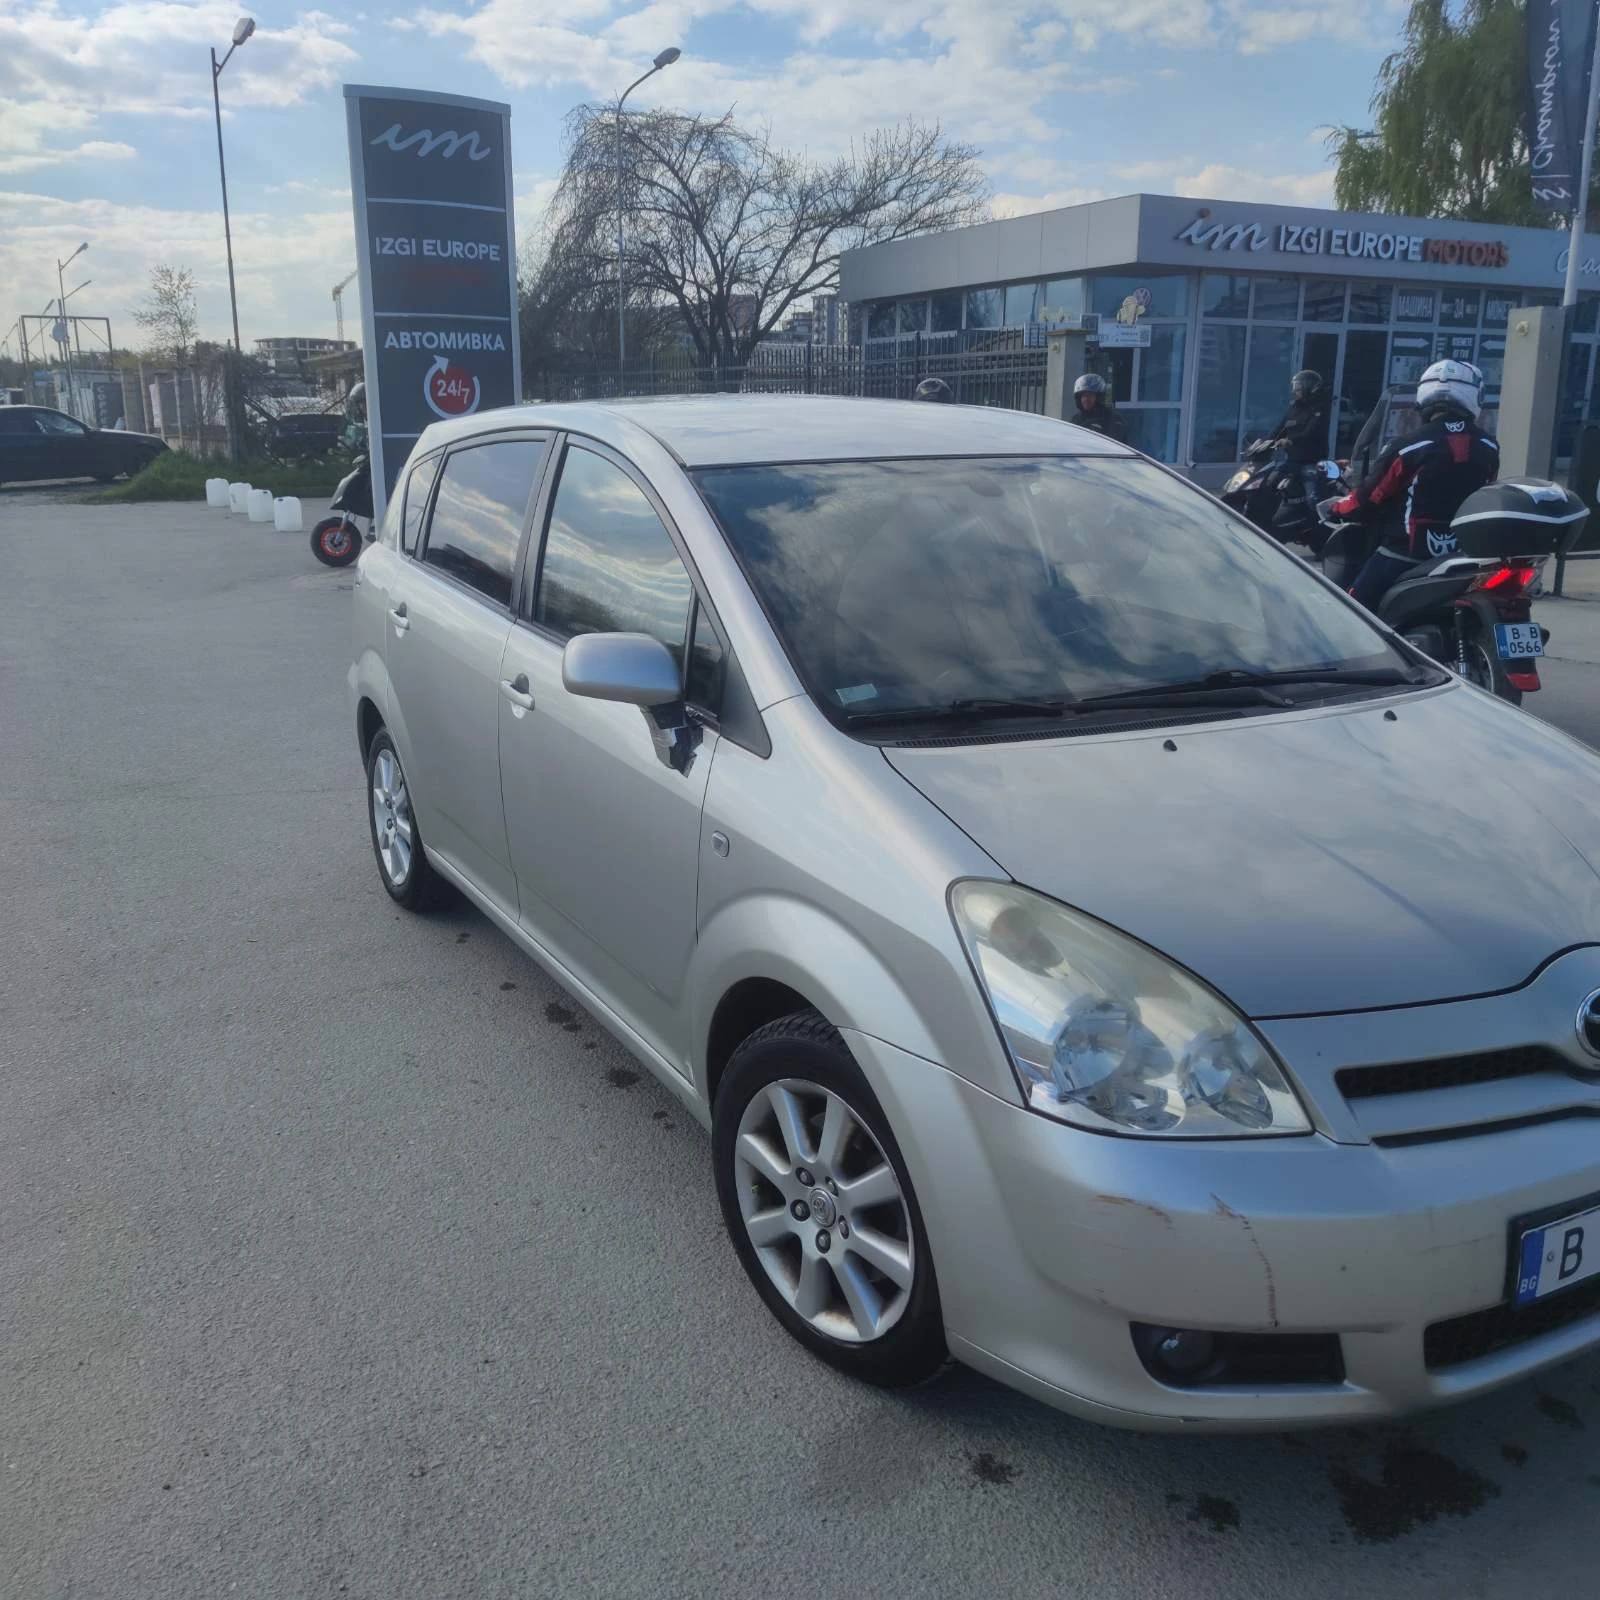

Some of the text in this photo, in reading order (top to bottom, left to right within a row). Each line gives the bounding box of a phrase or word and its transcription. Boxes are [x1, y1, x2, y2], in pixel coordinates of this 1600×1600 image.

[375, 236, 501, 261] IZGI EUROPE
[1279, 223, 1326, 254] IZGI
[1330, 227, 1421, 262] EUROPE
[1424, 238, 1510, 267] MOTORS
[384, 331, 506, 351] АВТОМИВКА
[436, 378, 470, 404] 24/7
[1512, 627, 1537, 639] B B
[1510, 641, 1541, 653] 0566
[1558, 1226, 1585, 1281] B
[1519, 1275, 1537, 1294] BG
